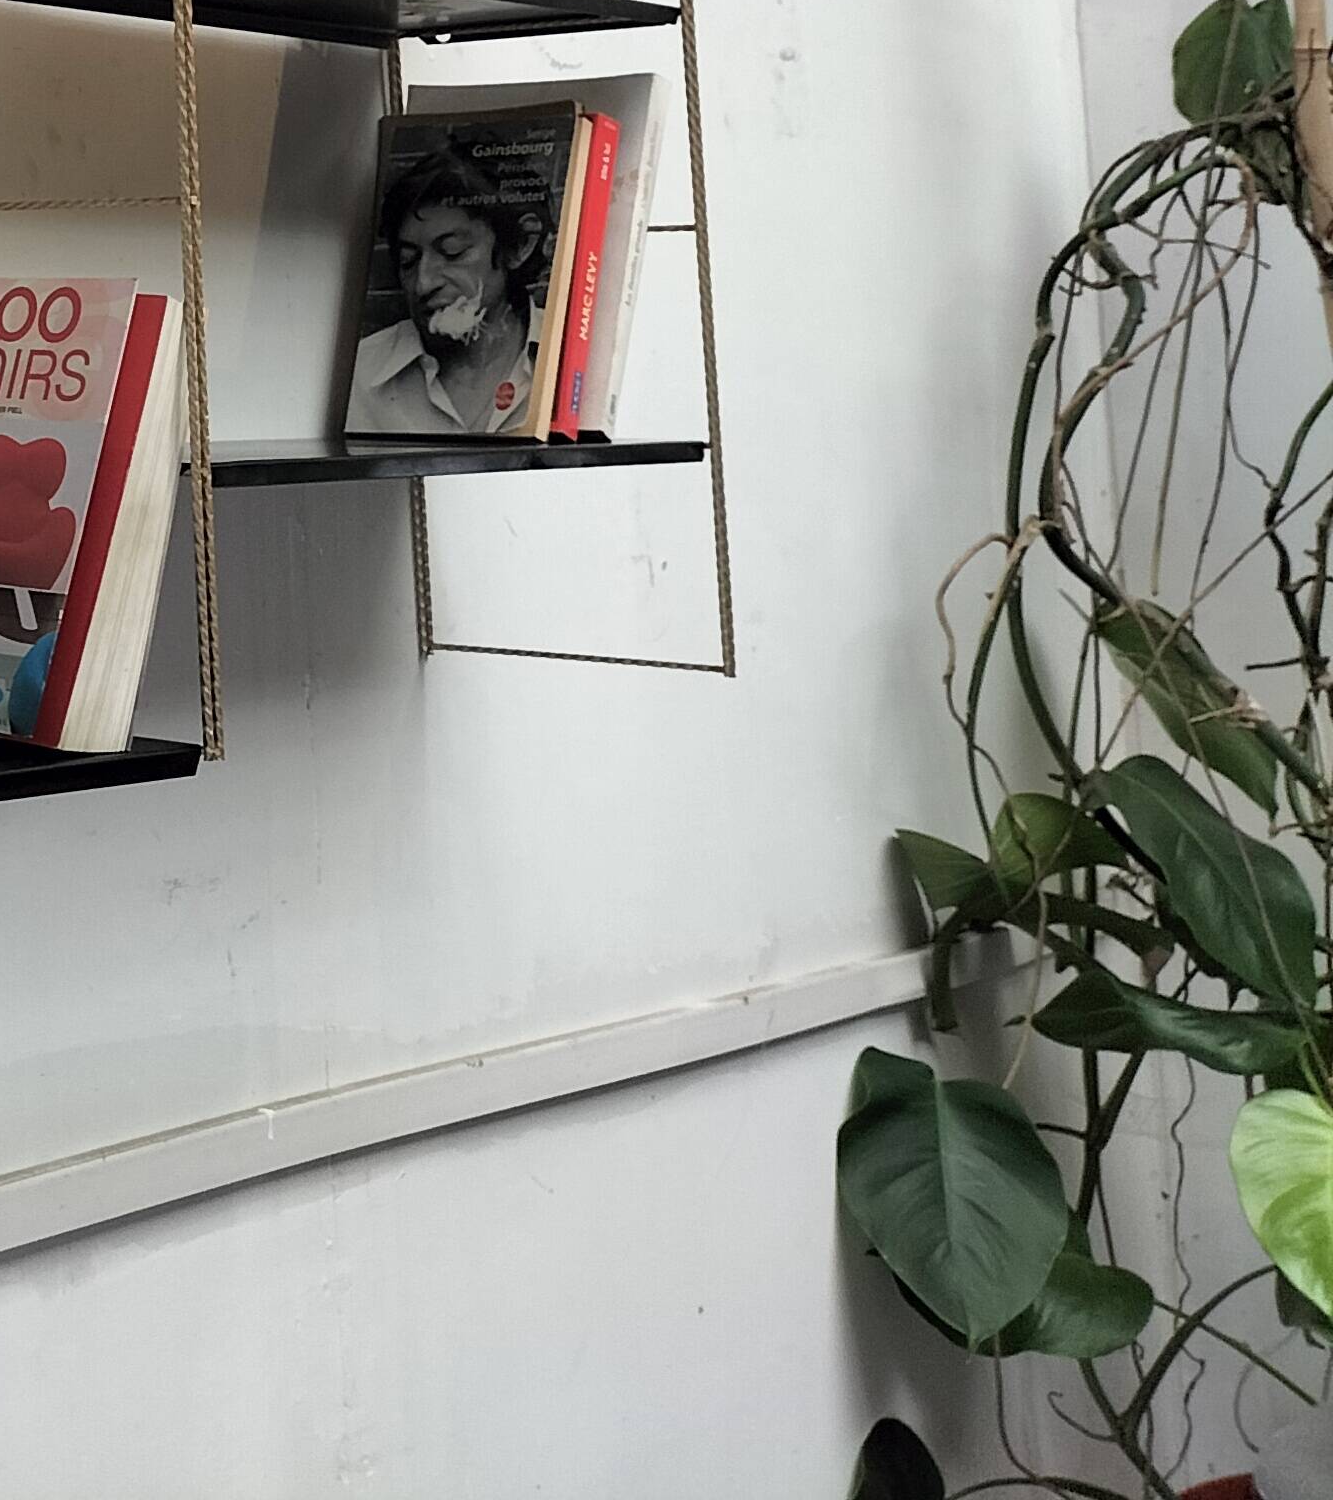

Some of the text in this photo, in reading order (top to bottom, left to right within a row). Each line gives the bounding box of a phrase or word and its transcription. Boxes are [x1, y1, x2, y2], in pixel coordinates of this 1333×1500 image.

[471, 141, 555, 157] Gainsbourg
[457, 192, 496, 205] autres
[498, 189, 545, 204] volutes
[579, 252, 598, 341] MARC LEVY
